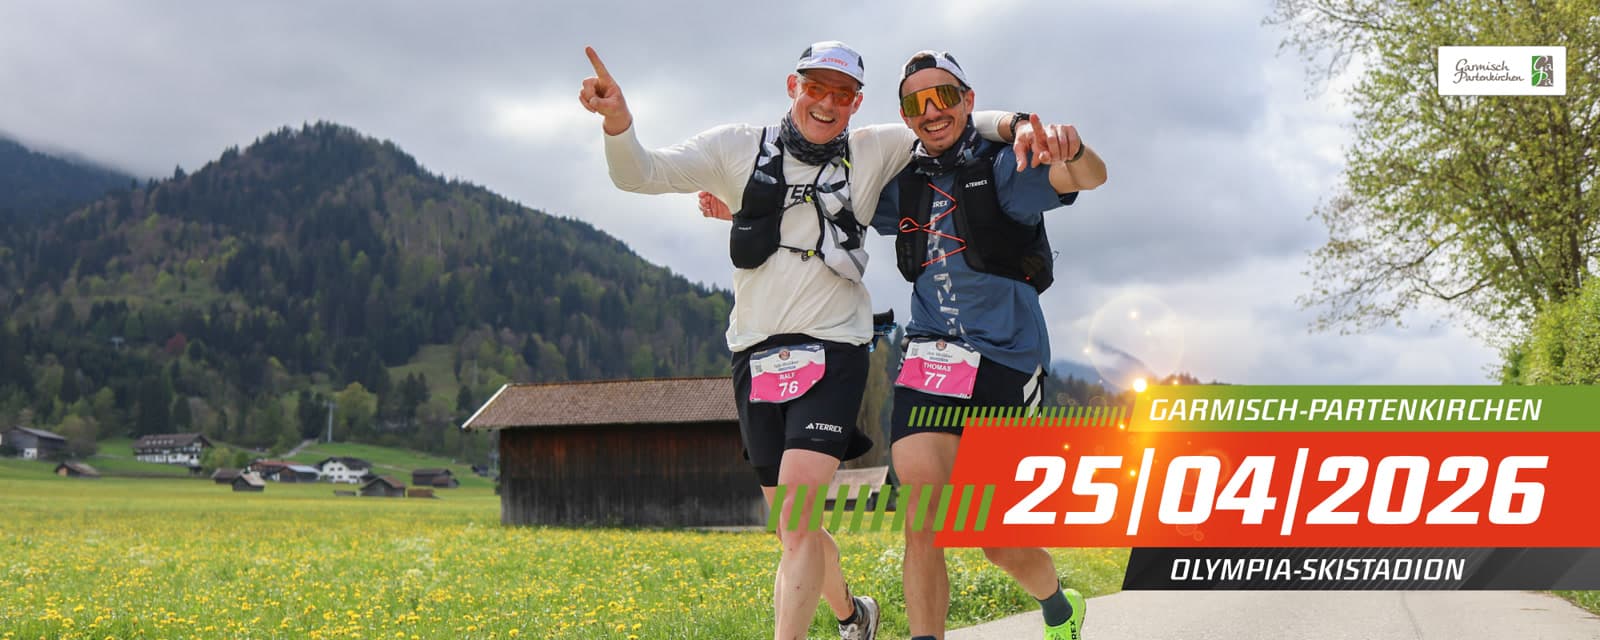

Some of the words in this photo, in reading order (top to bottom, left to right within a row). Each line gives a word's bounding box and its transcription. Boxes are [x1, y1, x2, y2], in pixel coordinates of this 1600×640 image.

[786, 183, 815, 200] TER
[932, 200, 948, 209] REX
[923, 362, 952, 372] THOMAS
[924, 371, 946, 389] 77
[778, 381, 799, 397] 76
[814, 422, 843, 433] TERREX
[1069, 619, 1077, 640] REX
